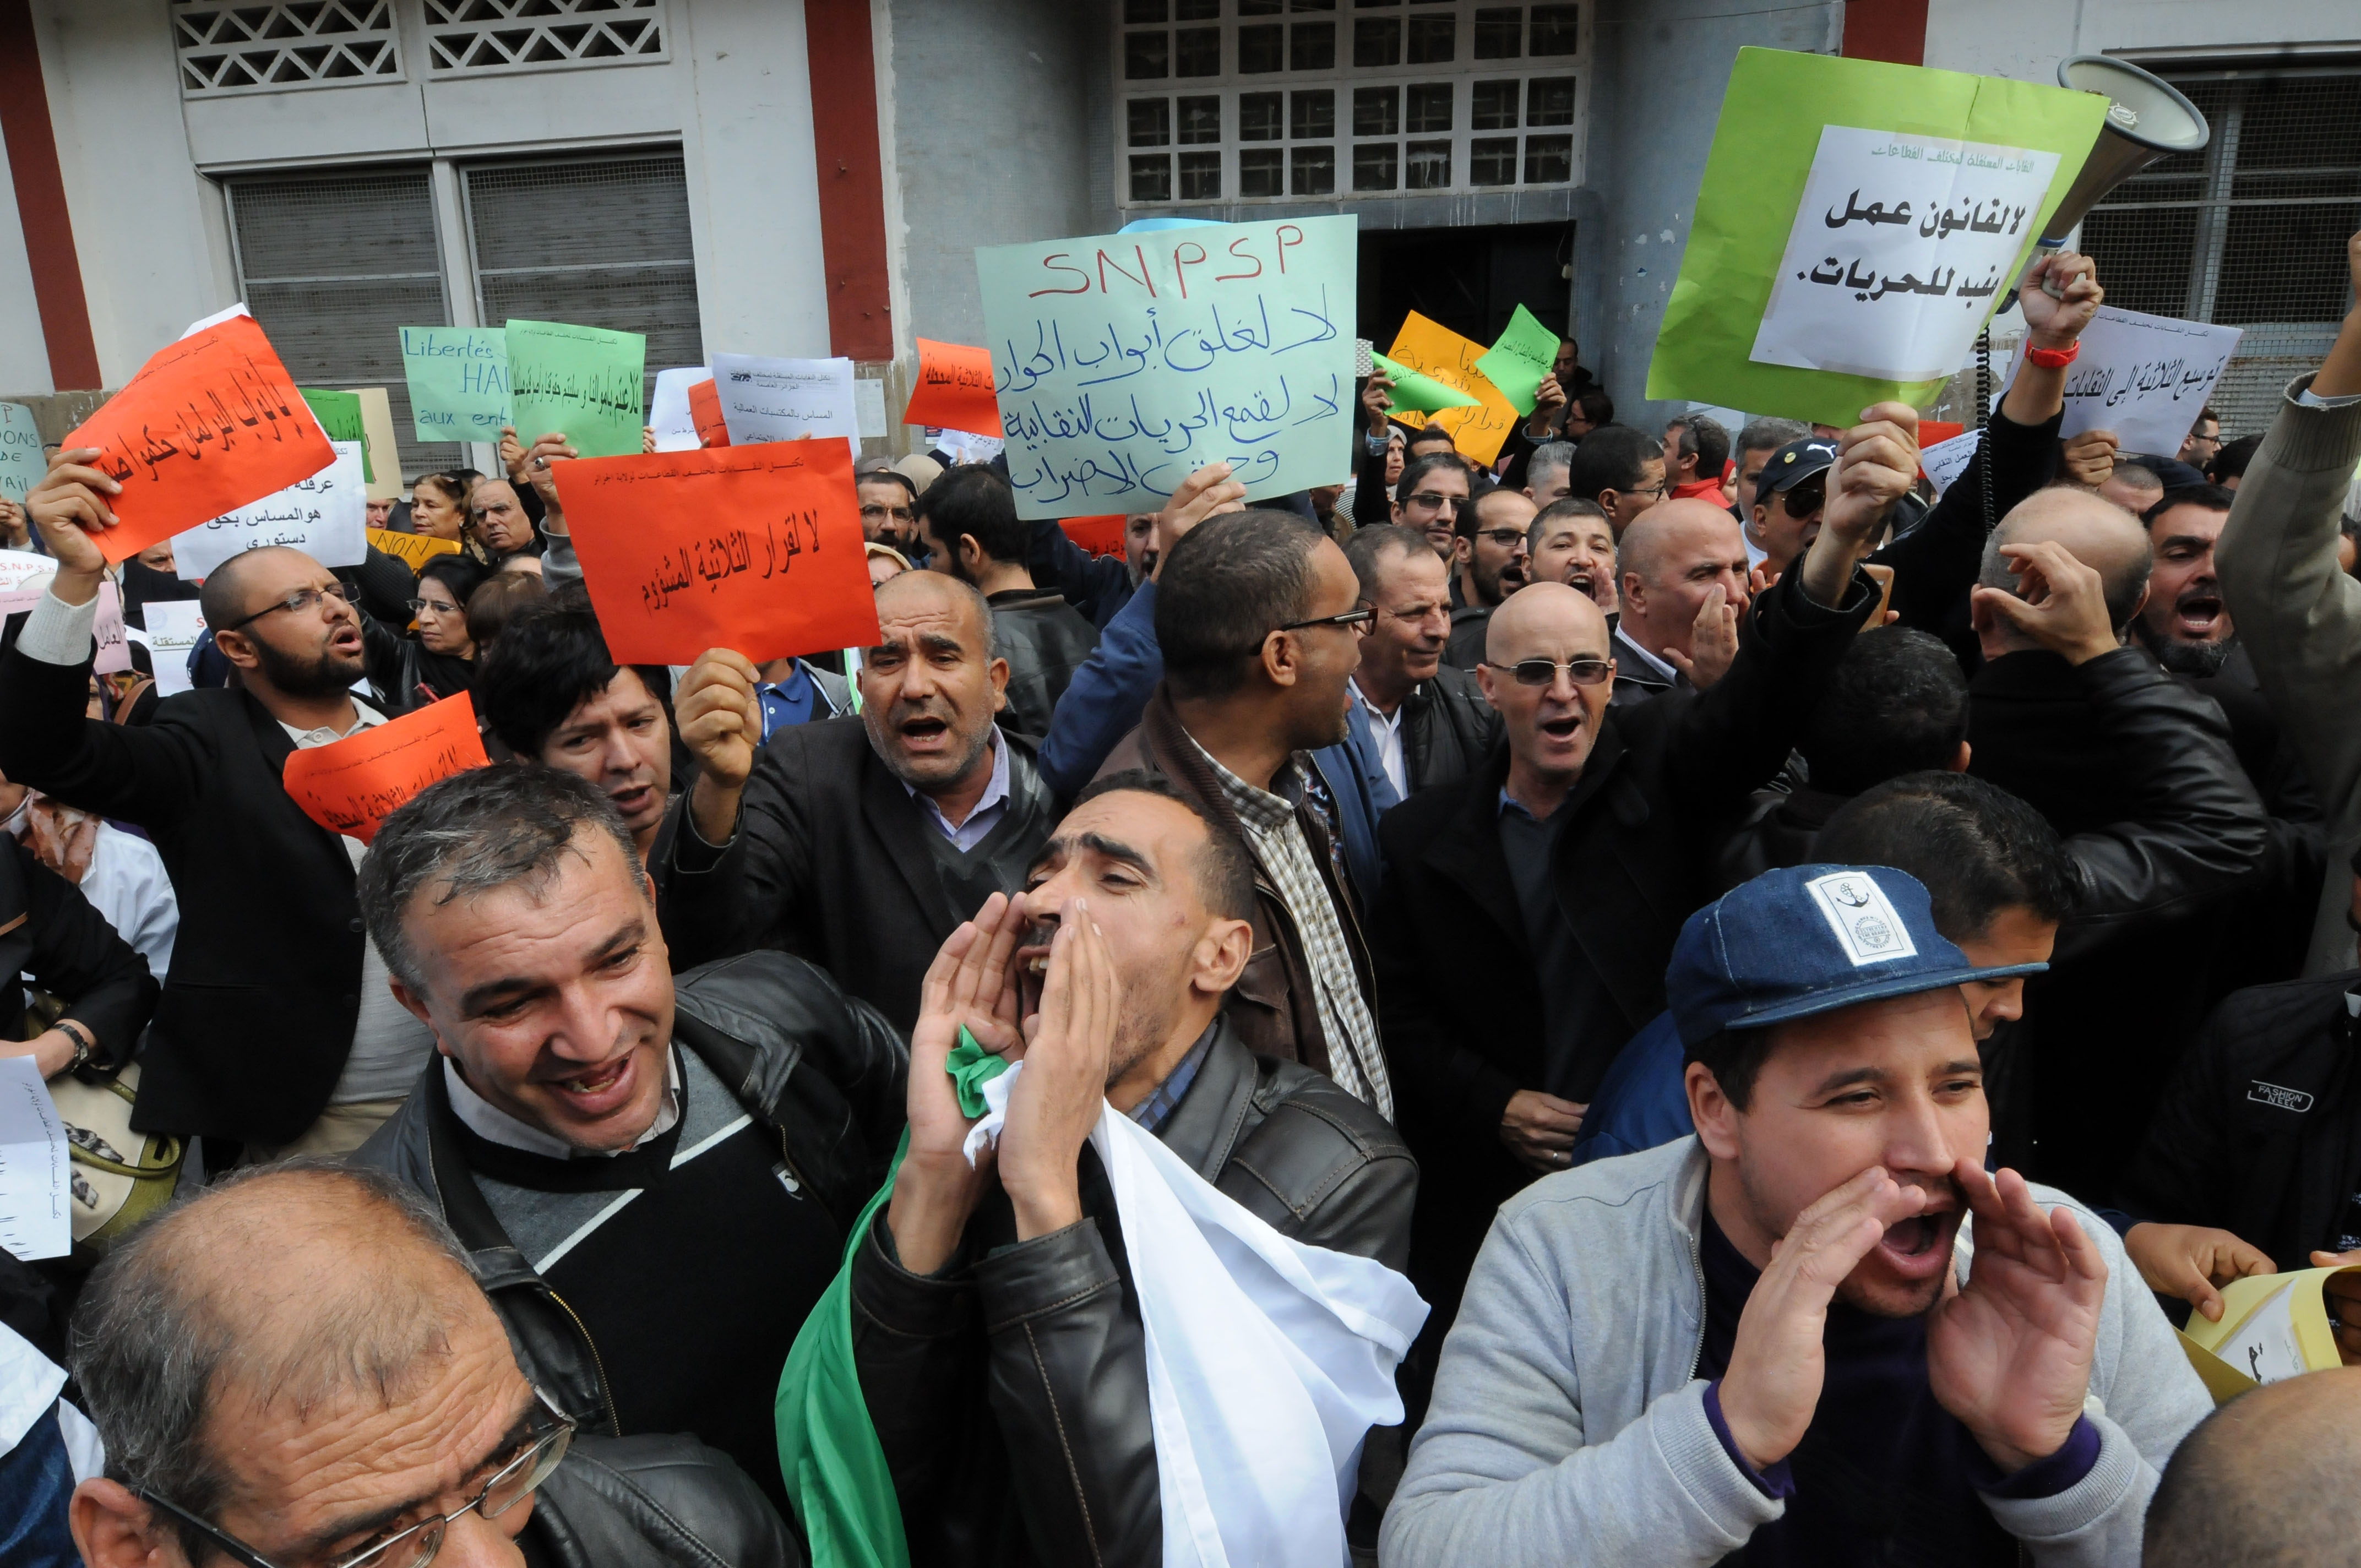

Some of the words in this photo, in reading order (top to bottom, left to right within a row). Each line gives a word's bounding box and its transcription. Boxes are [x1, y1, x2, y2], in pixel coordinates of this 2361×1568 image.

[1872, 144, 1924, 160] القطاعات
[1825, 188, 1913, 229] عمل
[1164, 293, 1270, 372] لغلق
[1271, 282, 1337, 355] لا
[404, 329, 493, 358] Libertés
[995, 319, 1066, 395] الحوار
[1074, 307, 1161, 386] أبواب
[459, 363, 512, 395] HAL
[1292, 373, 1339, 426] لا
[2137, 357, 2185, 401] الثلاثية
[2173, 355, 2226, 401] توسيع
[420, 410, 455, 426] aux
[733, 402, 757, 414] العمالية
[759, 407, 800, 418] بالمكتسبات
[802, 410, 833, 421] المساس
[1004, 392, 1094, 451] النقابية
[1095, 386, 1218, 454] الحريات
[1222, 374, 1290, 444] لقمع
[0, 430, 38, 448] ONS
[376, 532, 431, 556] NON
[762, 511, 801, 579] لقرار
[803, 508, 820, 553] لا
[698, 529, 752, 594] الثلاثية
[2258, 1085, 2303, 1103] FASHION
